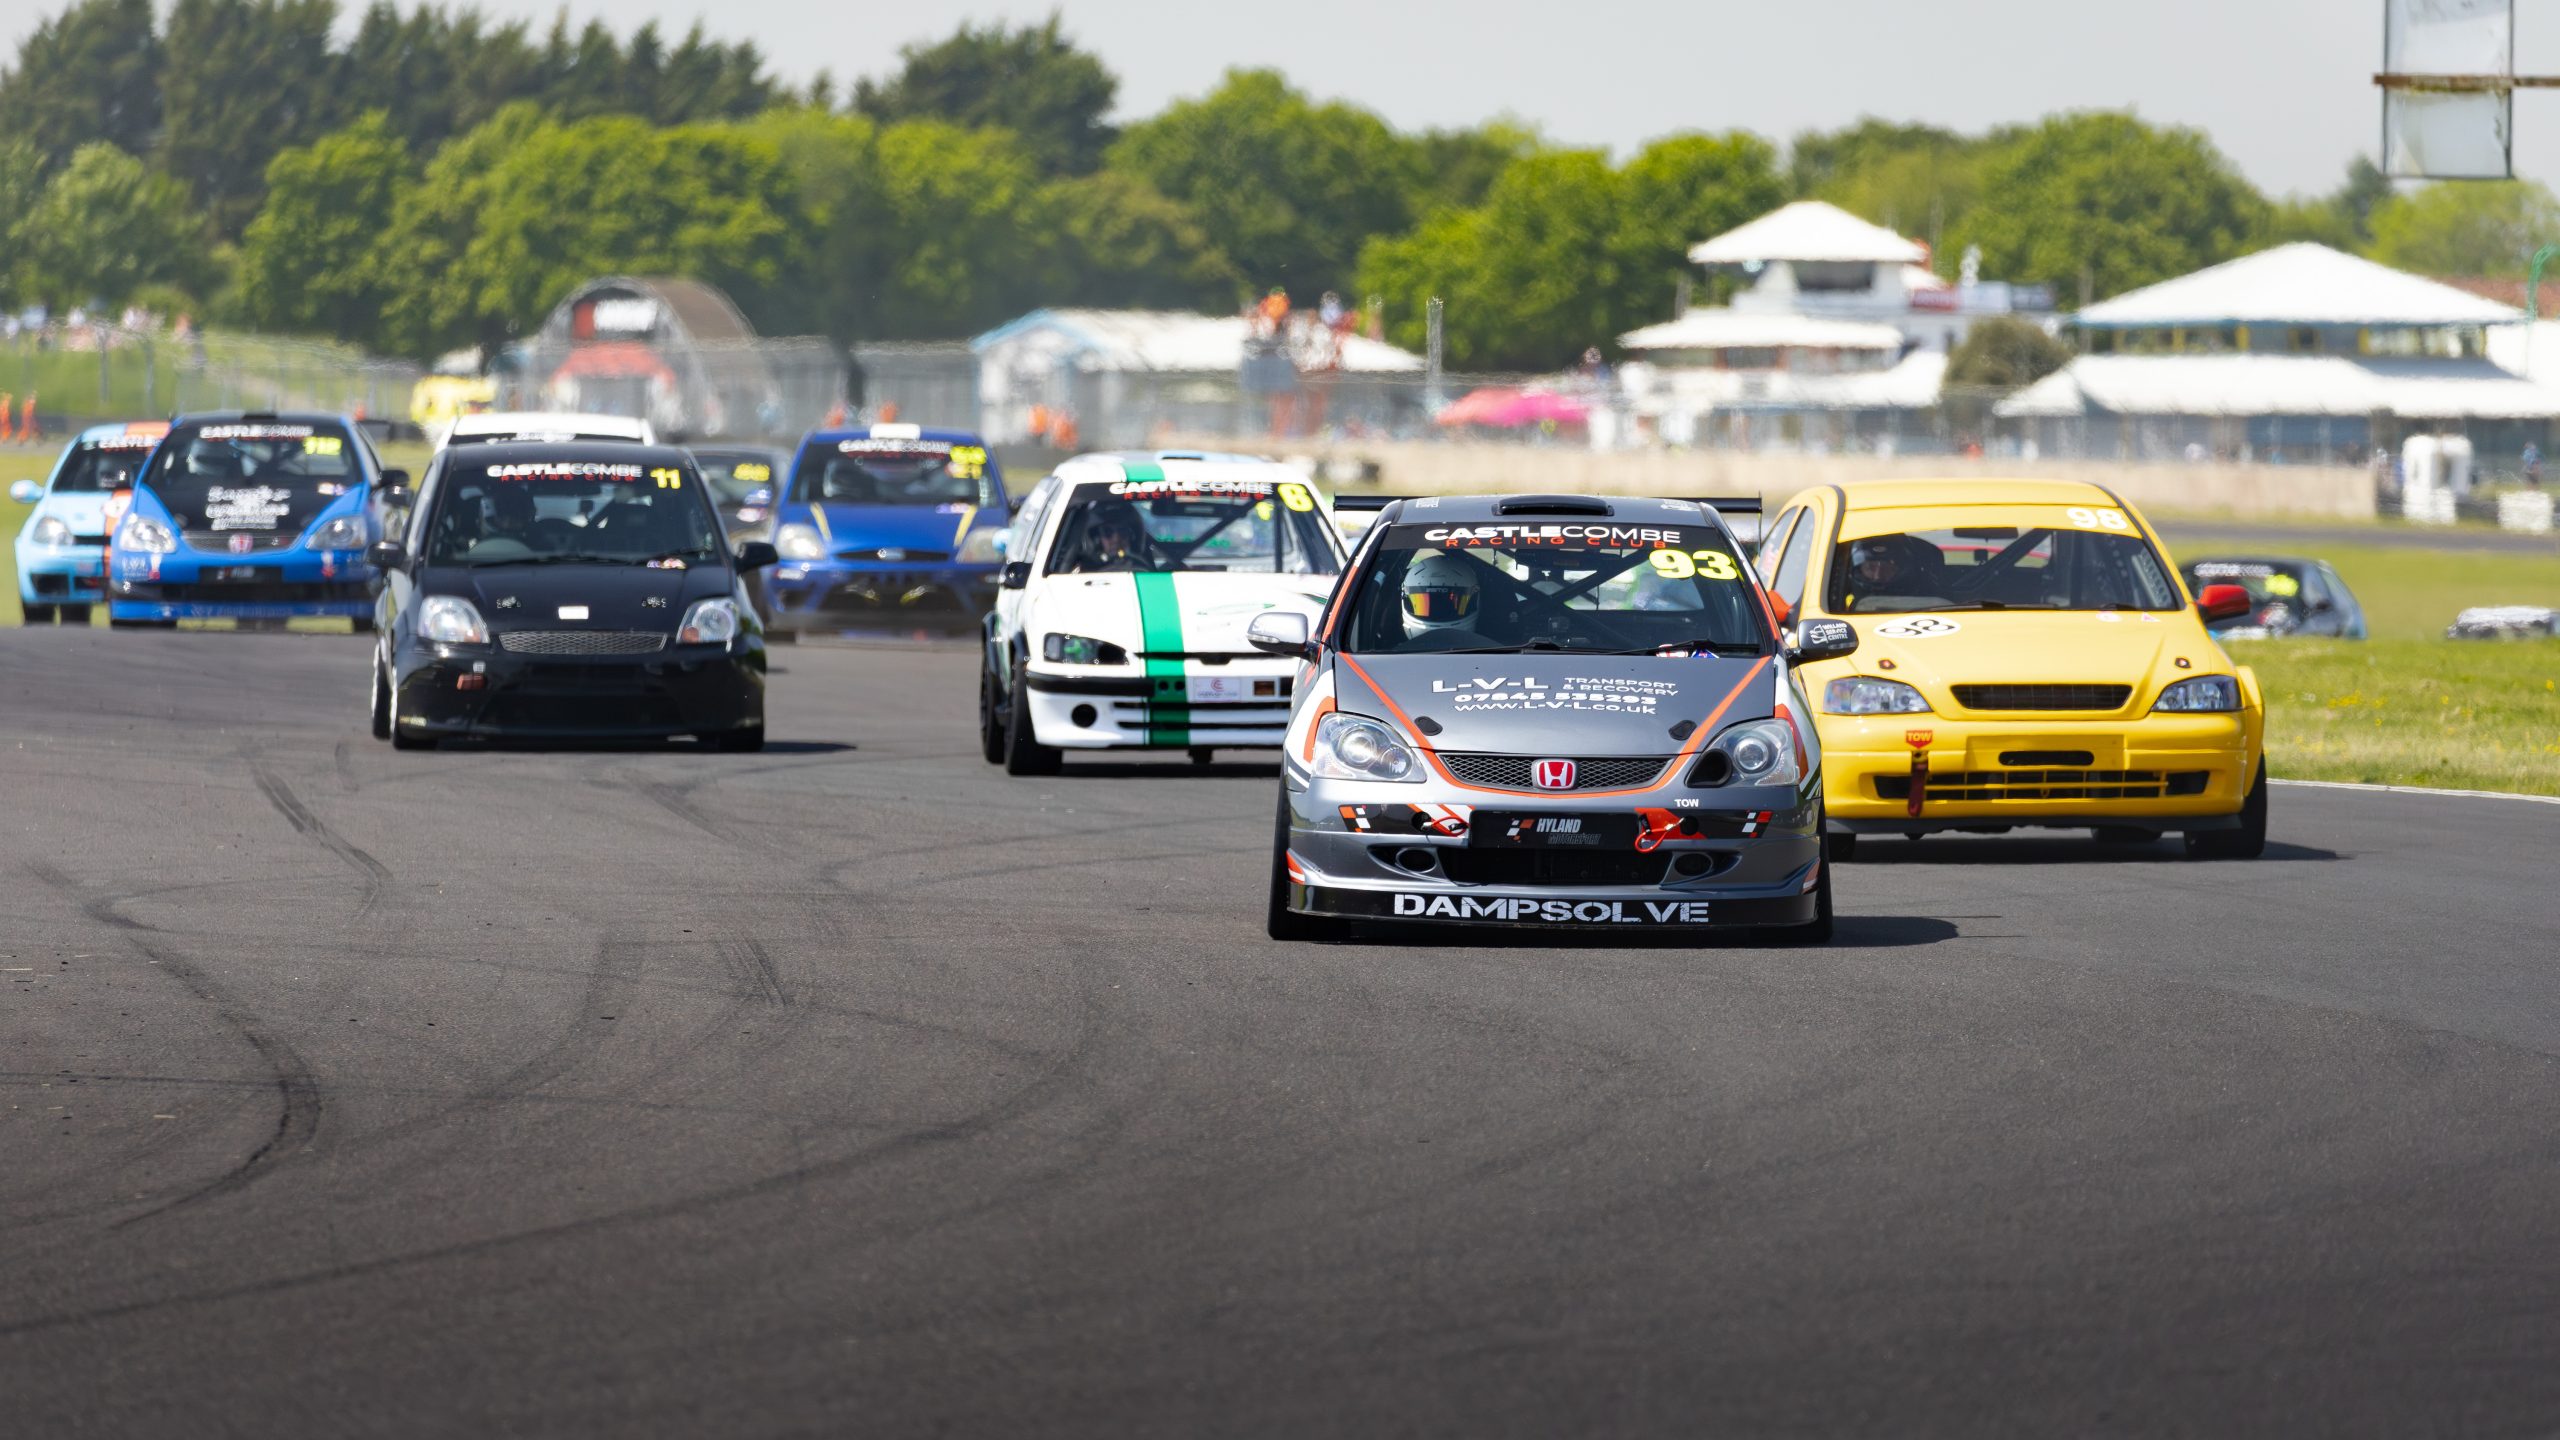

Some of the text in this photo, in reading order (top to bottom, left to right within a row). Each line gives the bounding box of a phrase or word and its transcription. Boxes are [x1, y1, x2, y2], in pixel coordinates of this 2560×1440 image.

[487, 463, 643, 478] CASTLECOMBE
[651, 468, 681, 489] 11
[1109, 481, 1273, 495] CASTLECOMBE
[2066, 507, 2128, 530] 98
[1424, 526, 1681, 544] CASTLECOMBE
[1446, 536, 1667, 549] RACING CLUB
[1649, 549, 1738, 580] 93
[1432, 677, 1549, 692] L-V-L
[1564, 677, 1676, 689] TRANSPORT
[1580, 684, 1679, 696] RECOVERY
[1454, 700, 1657, 715] www.L-V-L.co.uk
[1906, 732, 1933, 742] TOW
[1673, 798, 1699, 808] TOW
[1536, 817, 1582, 833] HYLAND
[1394, 893, 1709, 923] DAMPSOLVE
